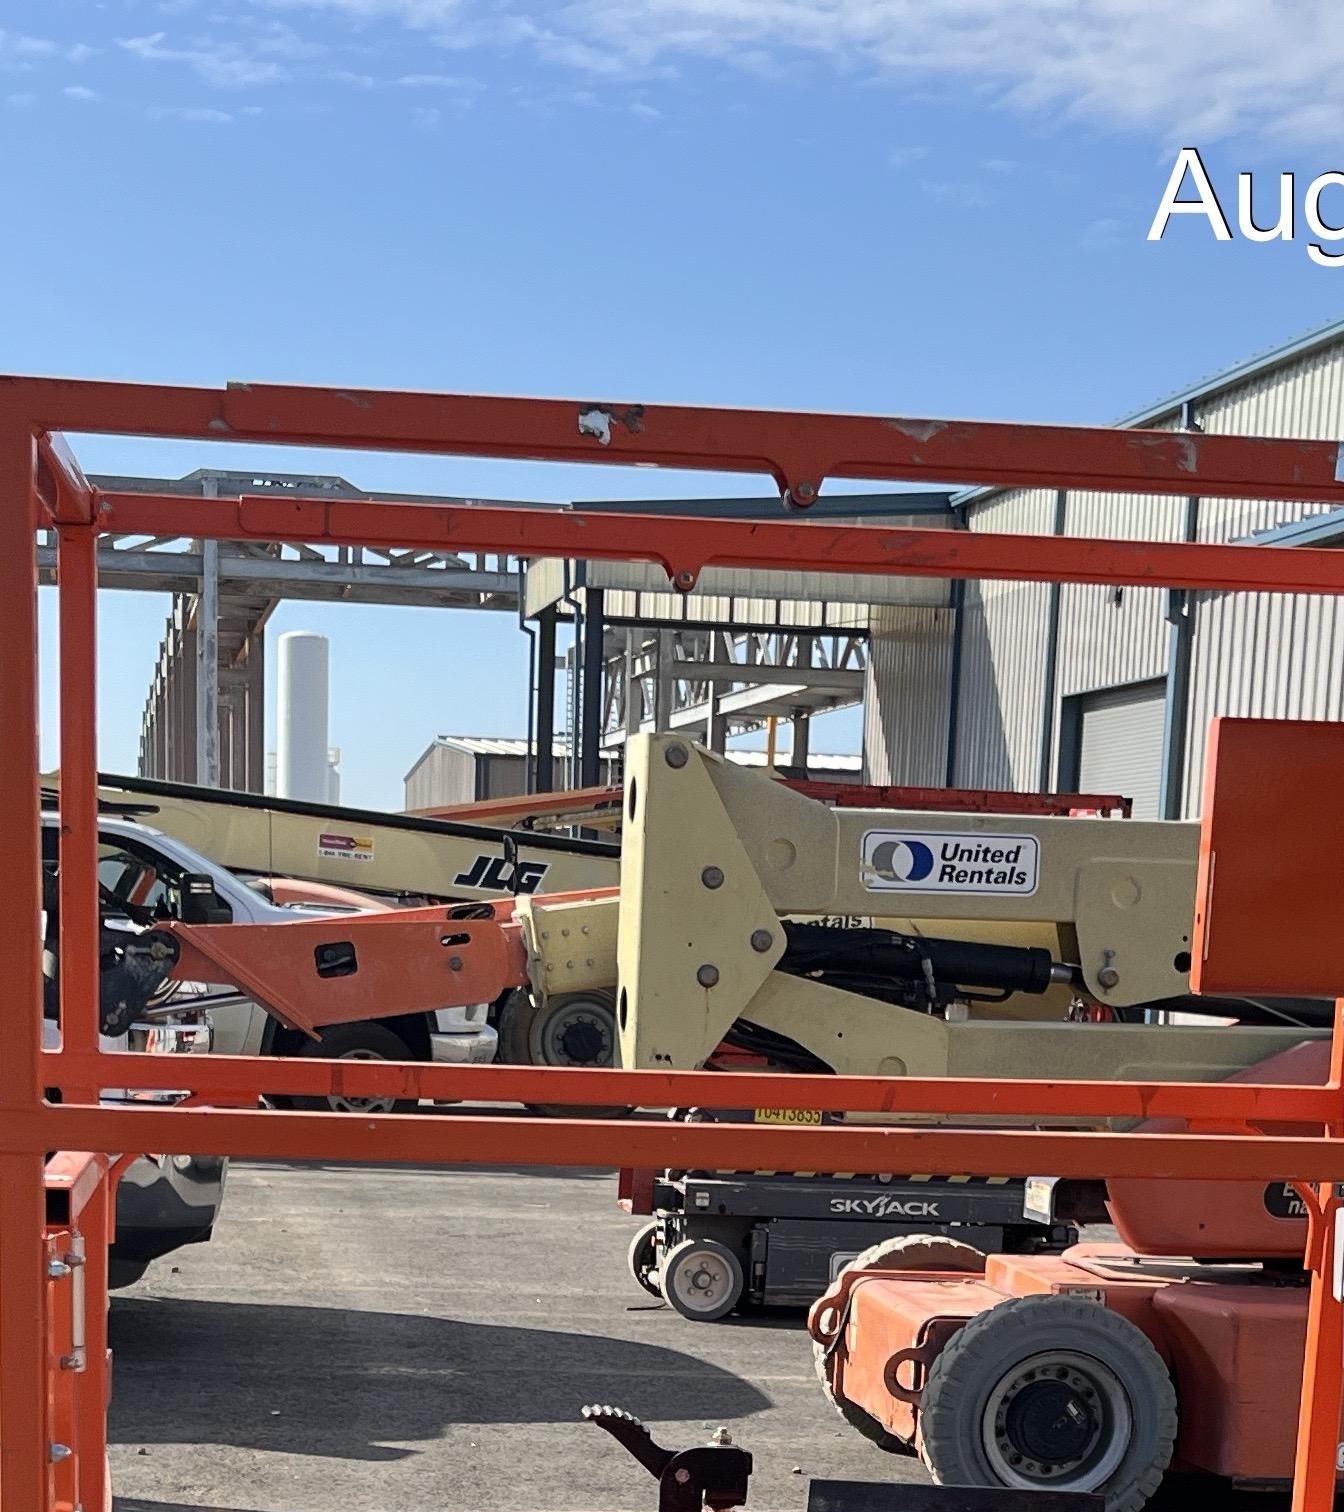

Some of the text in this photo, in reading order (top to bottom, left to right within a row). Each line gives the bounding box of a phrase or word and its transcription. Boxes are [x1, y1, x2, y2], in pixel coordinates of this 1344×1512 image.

[940, 843, 1022, 864] United
[453, 855, 550, 894] JLG
[938, 864, 1027, 885] Rentals
[830, 1194, 940, 1217] SKYJACK
